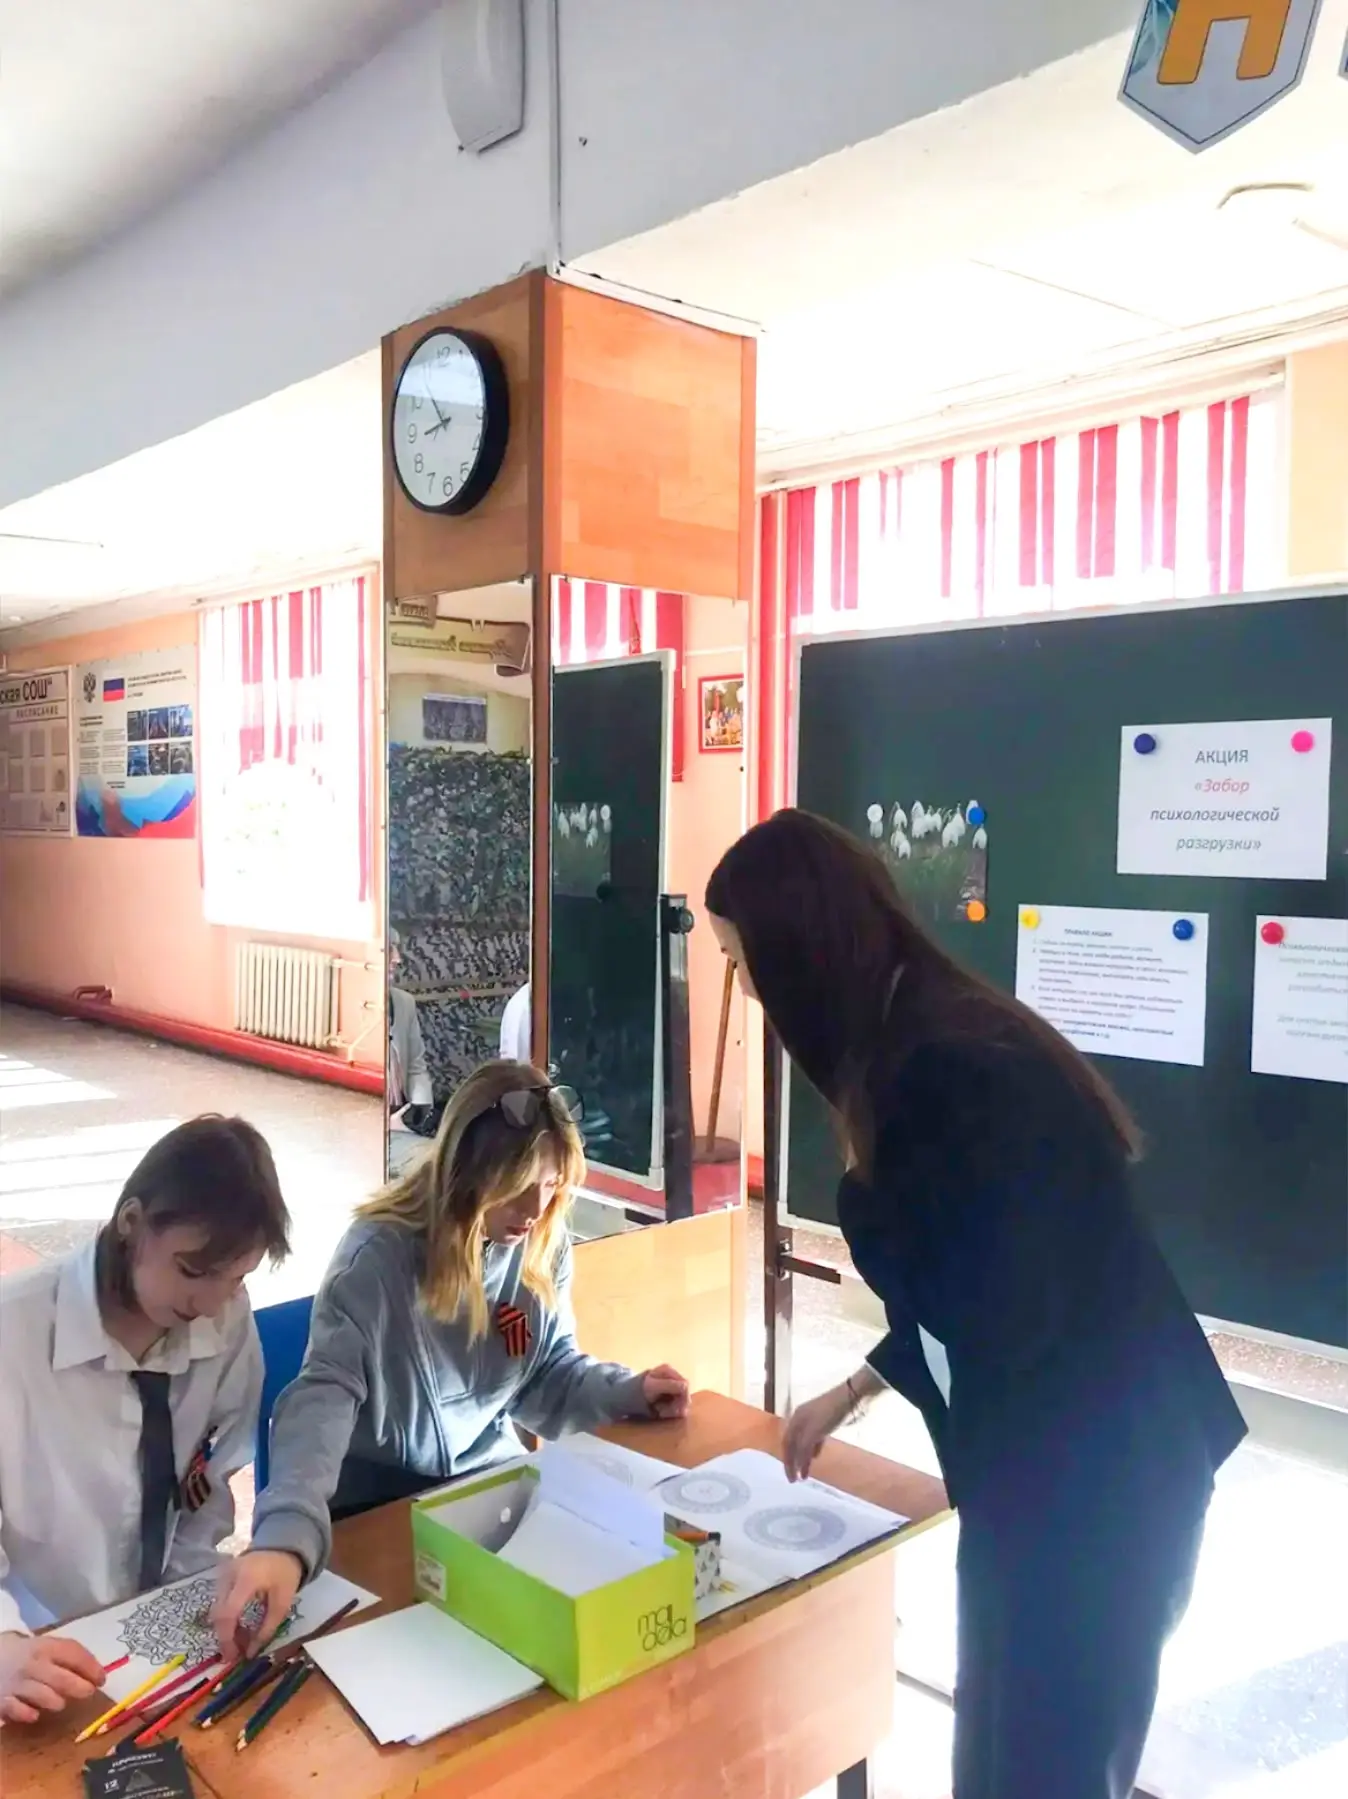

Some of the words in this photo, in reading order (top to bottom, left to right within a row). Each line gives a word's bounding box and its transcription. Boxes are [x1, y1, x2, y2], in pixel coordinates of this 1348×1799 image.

[407, 423, 417, 444] 9
[414, 452, 424, 474] 8
[459, 461, 470, 483] 5
[427, 472, 436, 494] 7
[442, 475, 453, 497] 6
[16, 704, 59, 719] РАСПИСАНИЕ
[1195, 749, 1249, 766] АКЦИЯ
[1194, 776, 1250, 795] «Забор
[1150, 806, 1280, 822] психологической
[1176, 836, 1262, 853] разгрузки»
